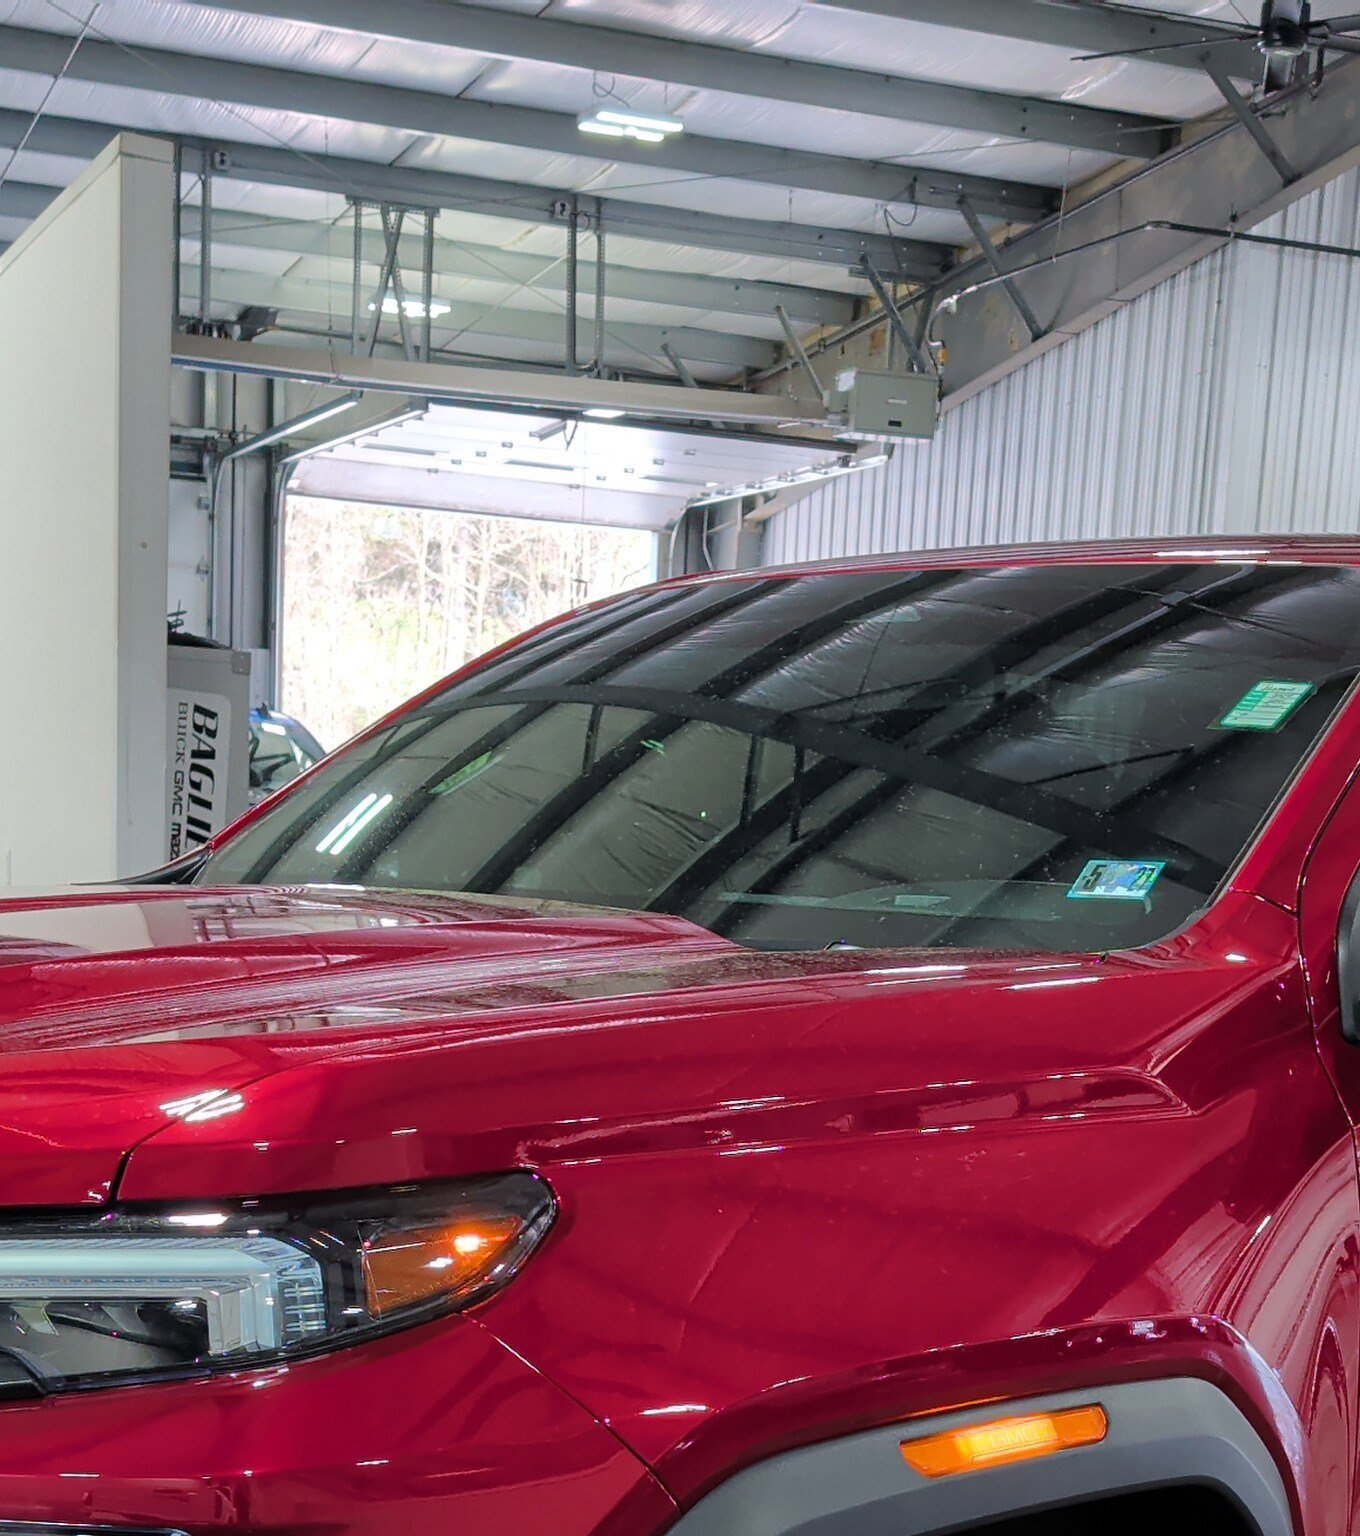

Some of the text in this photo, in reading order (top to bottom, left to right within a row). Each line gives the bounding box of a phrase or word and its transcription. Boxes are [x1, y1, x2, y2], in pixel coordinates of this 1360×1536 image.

[174, 702, 189, 765] BUICK
[171, 770, 185, 816] GMC
[1082, 864, 1107, 891] 5
